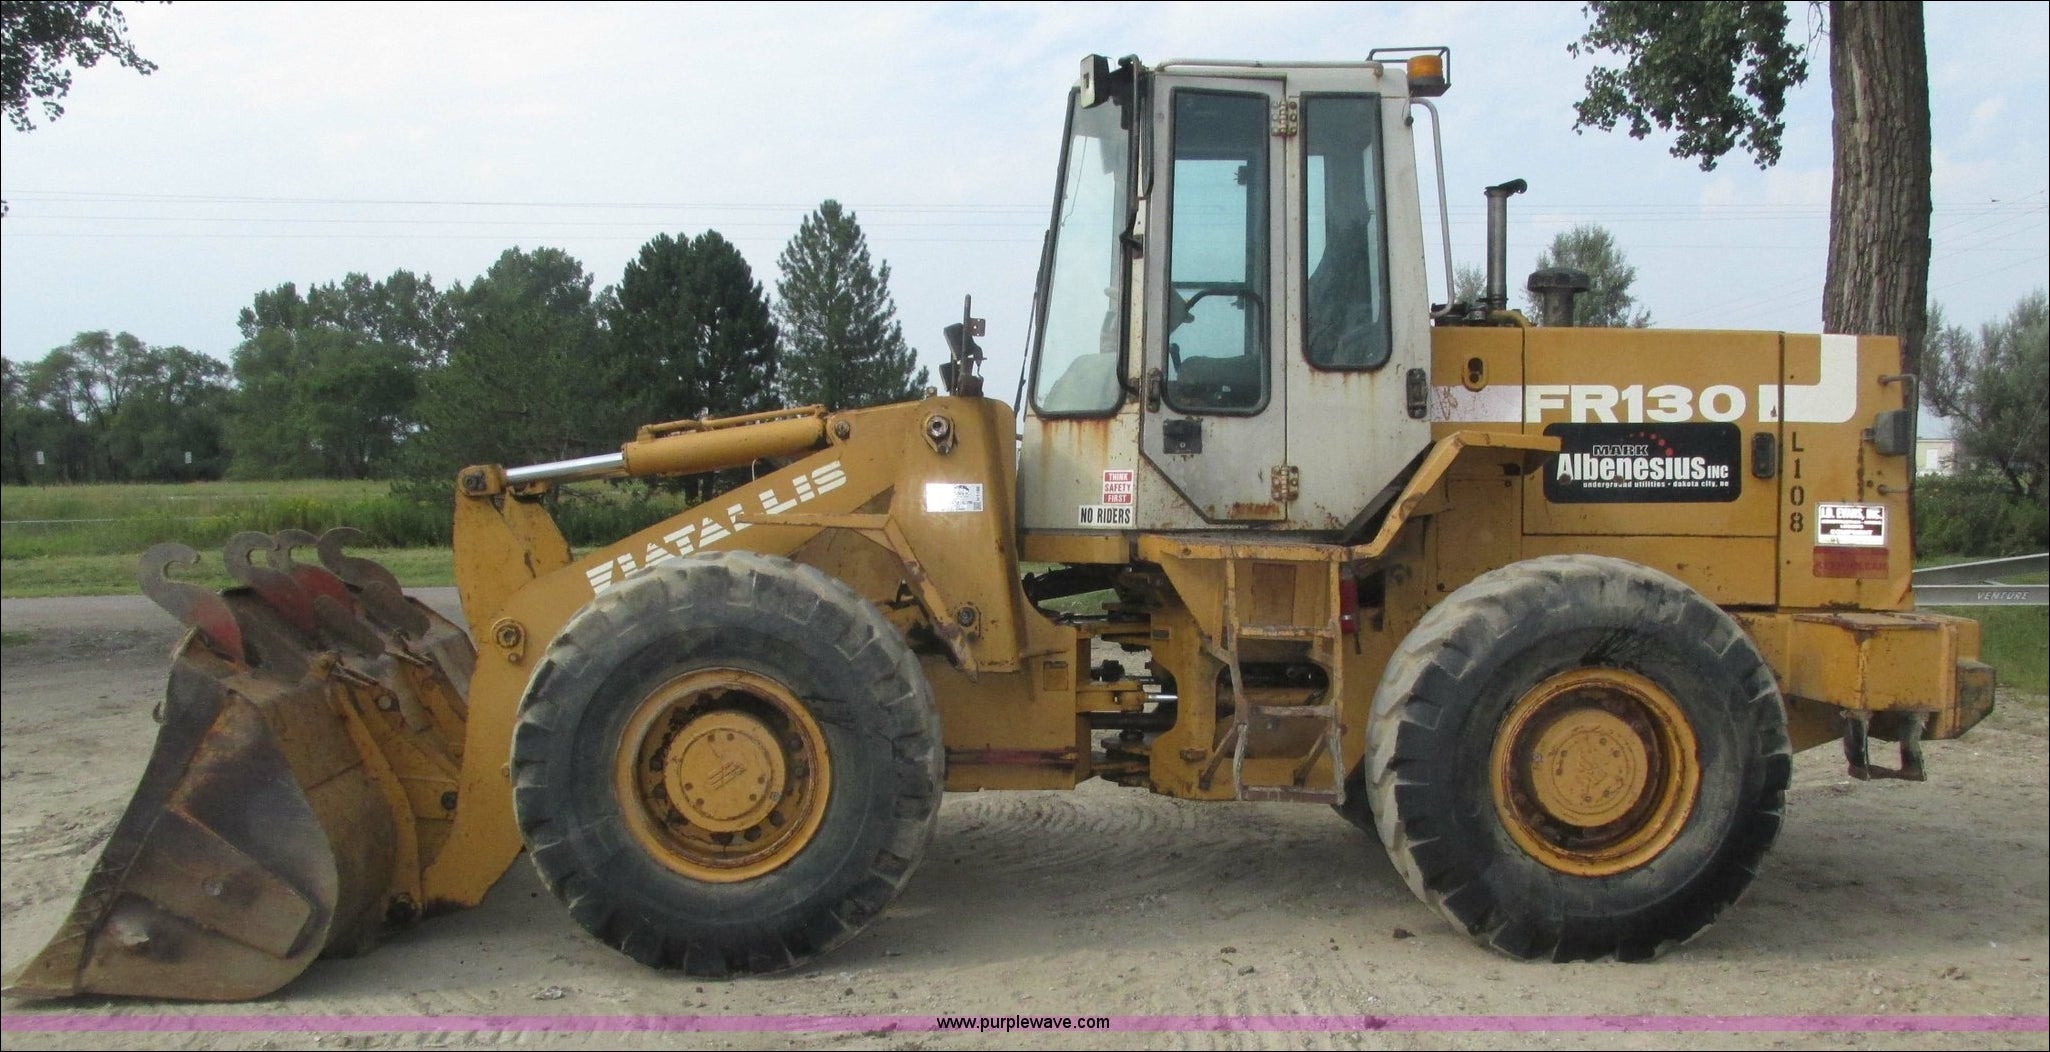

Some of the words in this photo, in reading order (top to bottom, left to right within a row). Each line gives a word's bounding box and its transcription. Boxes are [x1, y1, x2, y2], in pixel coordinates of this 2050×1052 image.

[1526, 384, 1747, 423] FR130
[1592, 444, 1650, 457] MARK
[1556, 452, 1706, 481] Albenesius
[1707, 464, 1730, 479] INC
[1109, 472, 1129, 481] THINK
[1104, 483, 1131, 492] SAFETY
[1634, 480, 1666, 488] utilities
[1673, 480, 1699, 488] dakota
[1107, 494, 1127, 503] FIRST
[1080, 507, 1094, 523] NO
[1097, 507, 1131, 524] RIDERS
[1977, 591, 2030, 600] VENTURE
